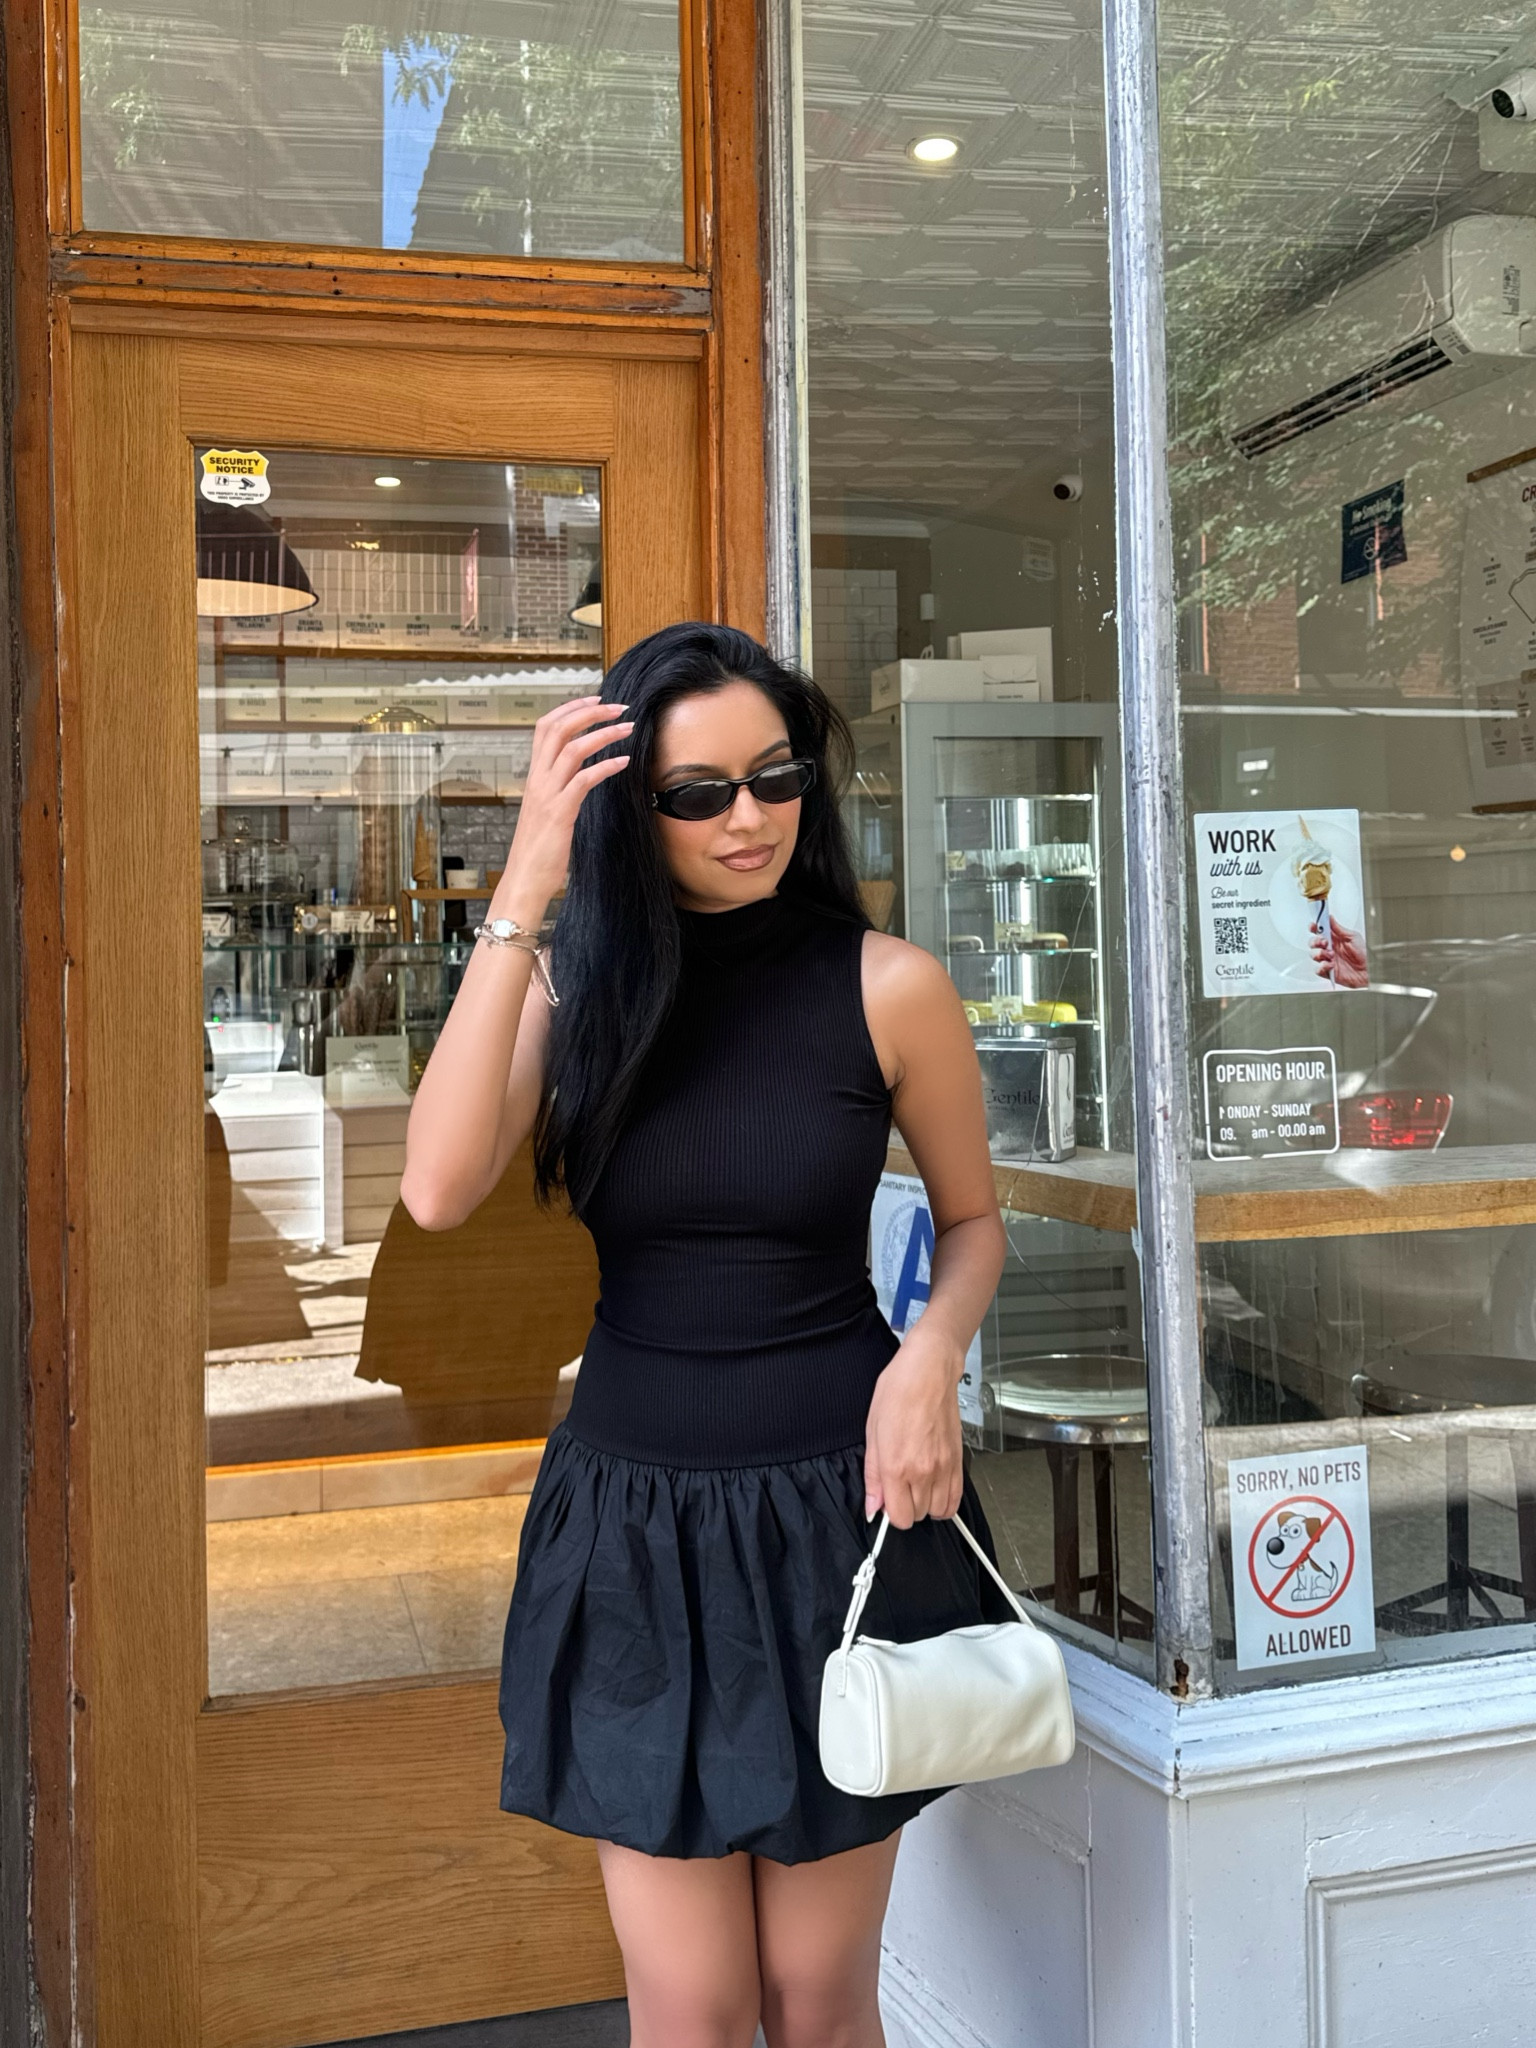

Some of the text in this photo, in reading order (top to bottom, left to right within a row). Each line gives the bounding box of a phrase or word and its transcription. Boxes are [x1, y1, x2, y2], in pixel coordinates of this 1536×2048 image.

[209, 457, 260, 466] SECURITY
[216, 466, 254, 474] NOTICE
[1208, 829, 1276, 854] WORK
[1210, 855, 1263, 877] with us
[1211, 899, 1271, 910] secret ingredient
[1216, 1062, 1326, 1083] OPENING HOUR
[1271, 1103, 1311, 1118] SUNDAY
[1251, 1128, 1268, 1139] am
[1278, 1123, 1307, 1137] 00.00
[1308, 1124, 1326, 1136] am
[880, 1180, 926, 1196] SANITARY INSPEC
[891, 1206, 935, 1333] A
[1237, 1461, 1361, 1494] SORRY, NO PETS
[1266, 1624, 1351, 1657] ALLOWED
